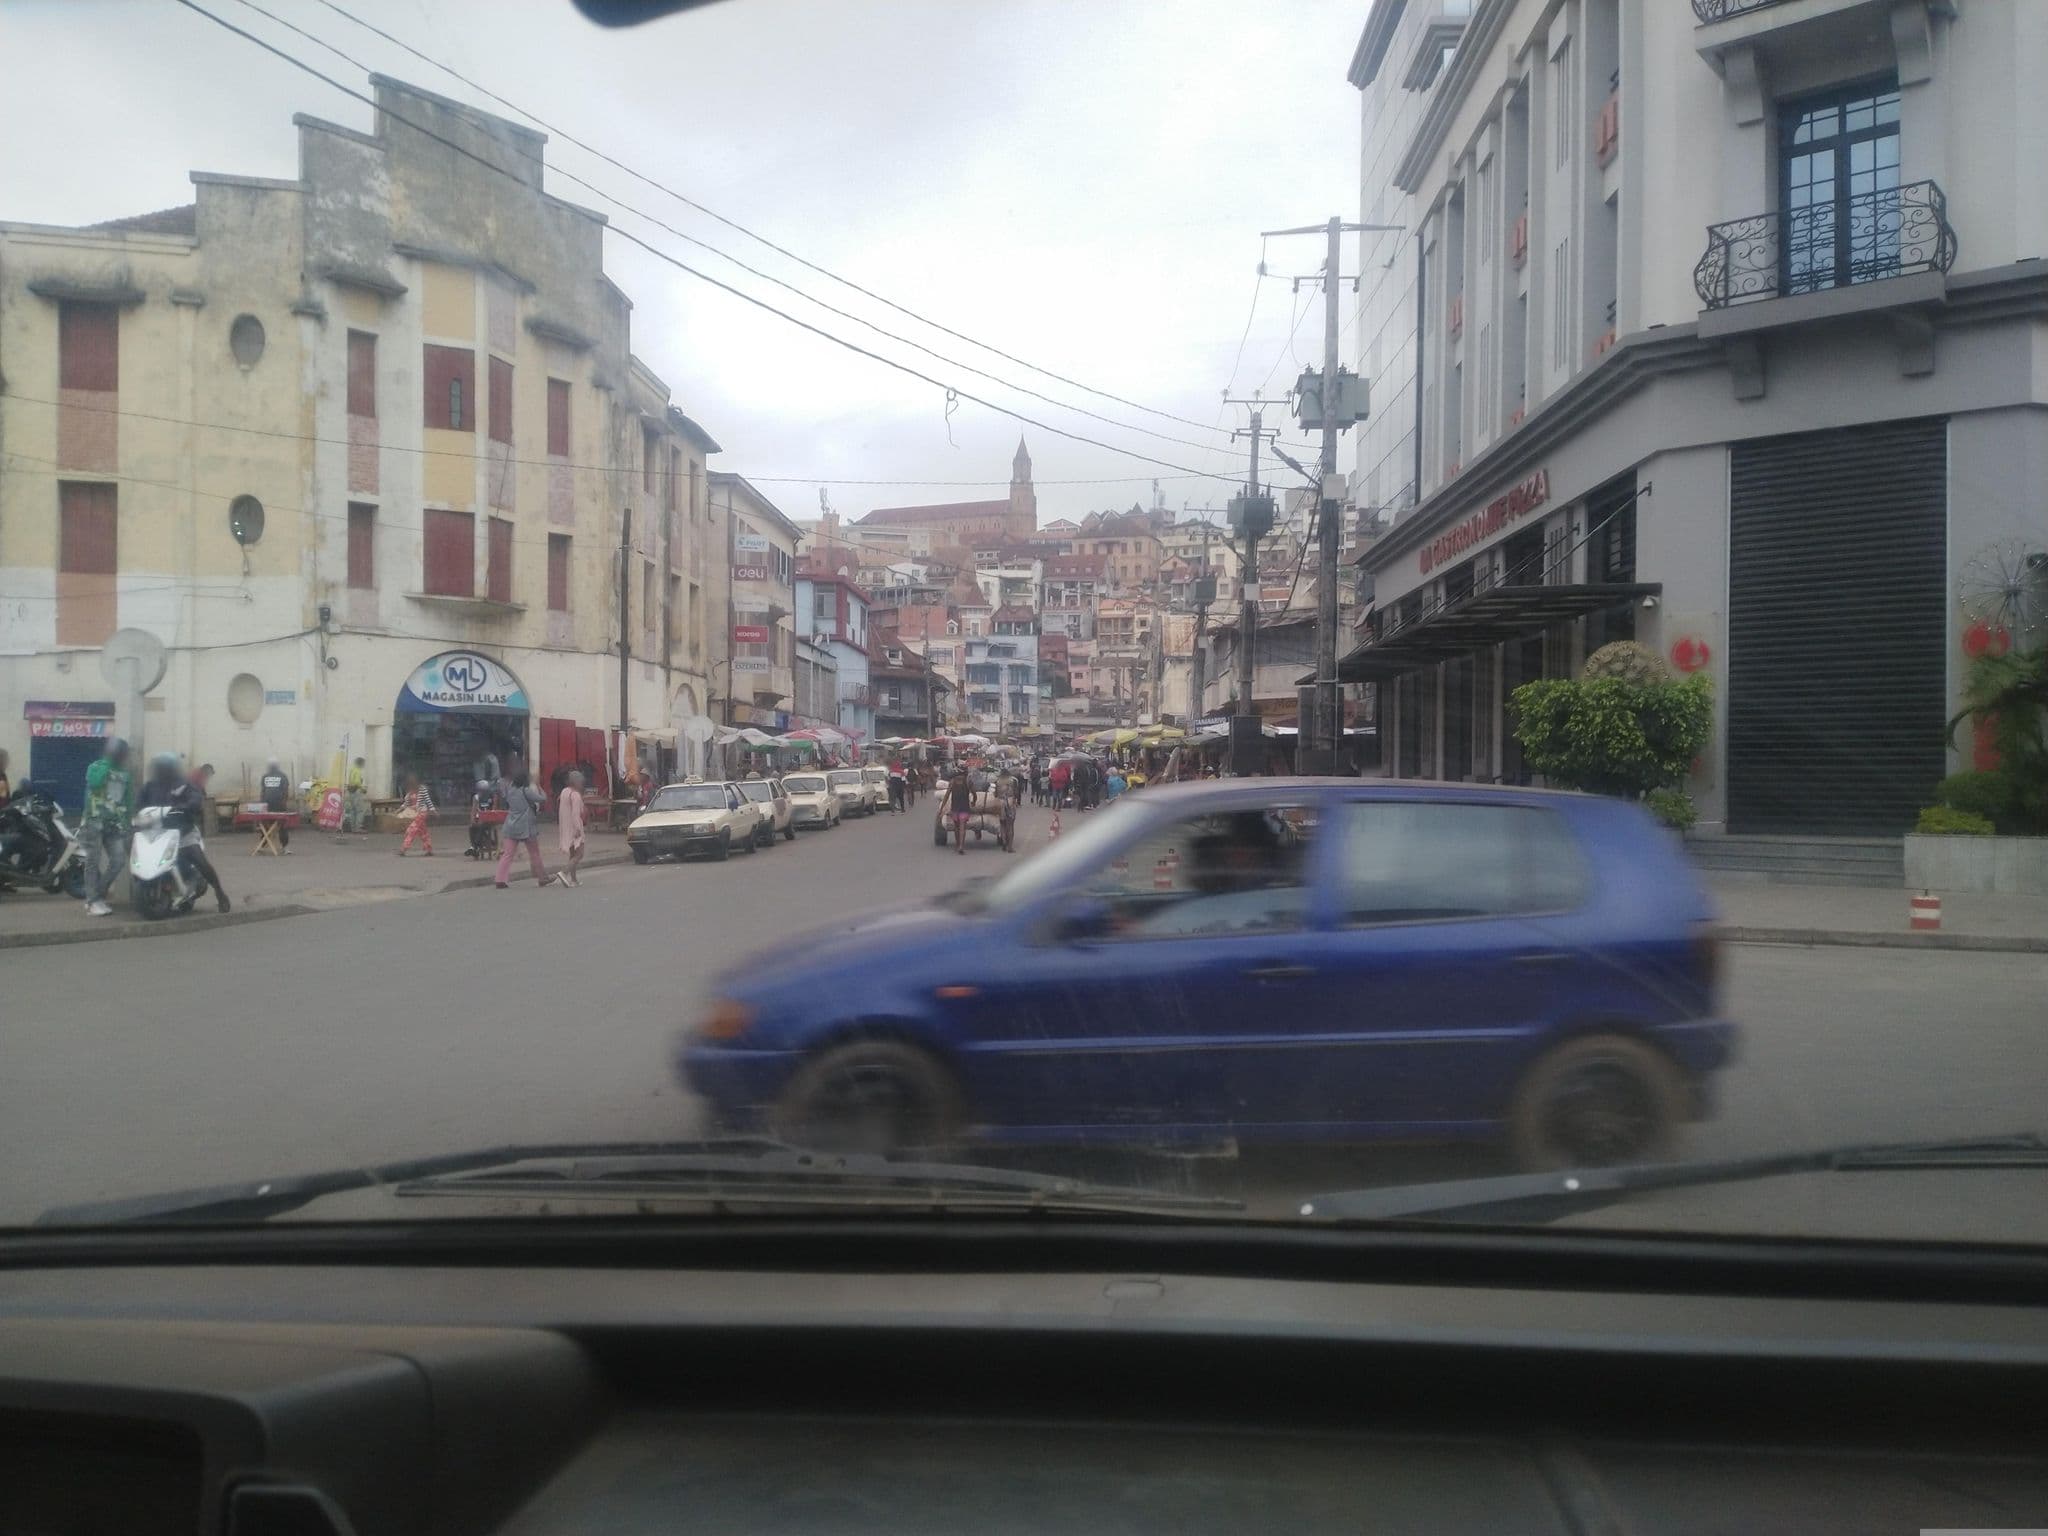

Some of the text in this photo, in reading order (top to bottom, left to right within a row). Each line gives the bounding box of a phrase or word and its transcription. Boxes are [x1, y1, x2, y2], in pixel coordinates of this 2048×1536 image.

[1508, 469, 1551, 521] PIZZA
[738, 567, 764, 579] deli
[421, 691, 508, 704] MAGASIN LILAS
